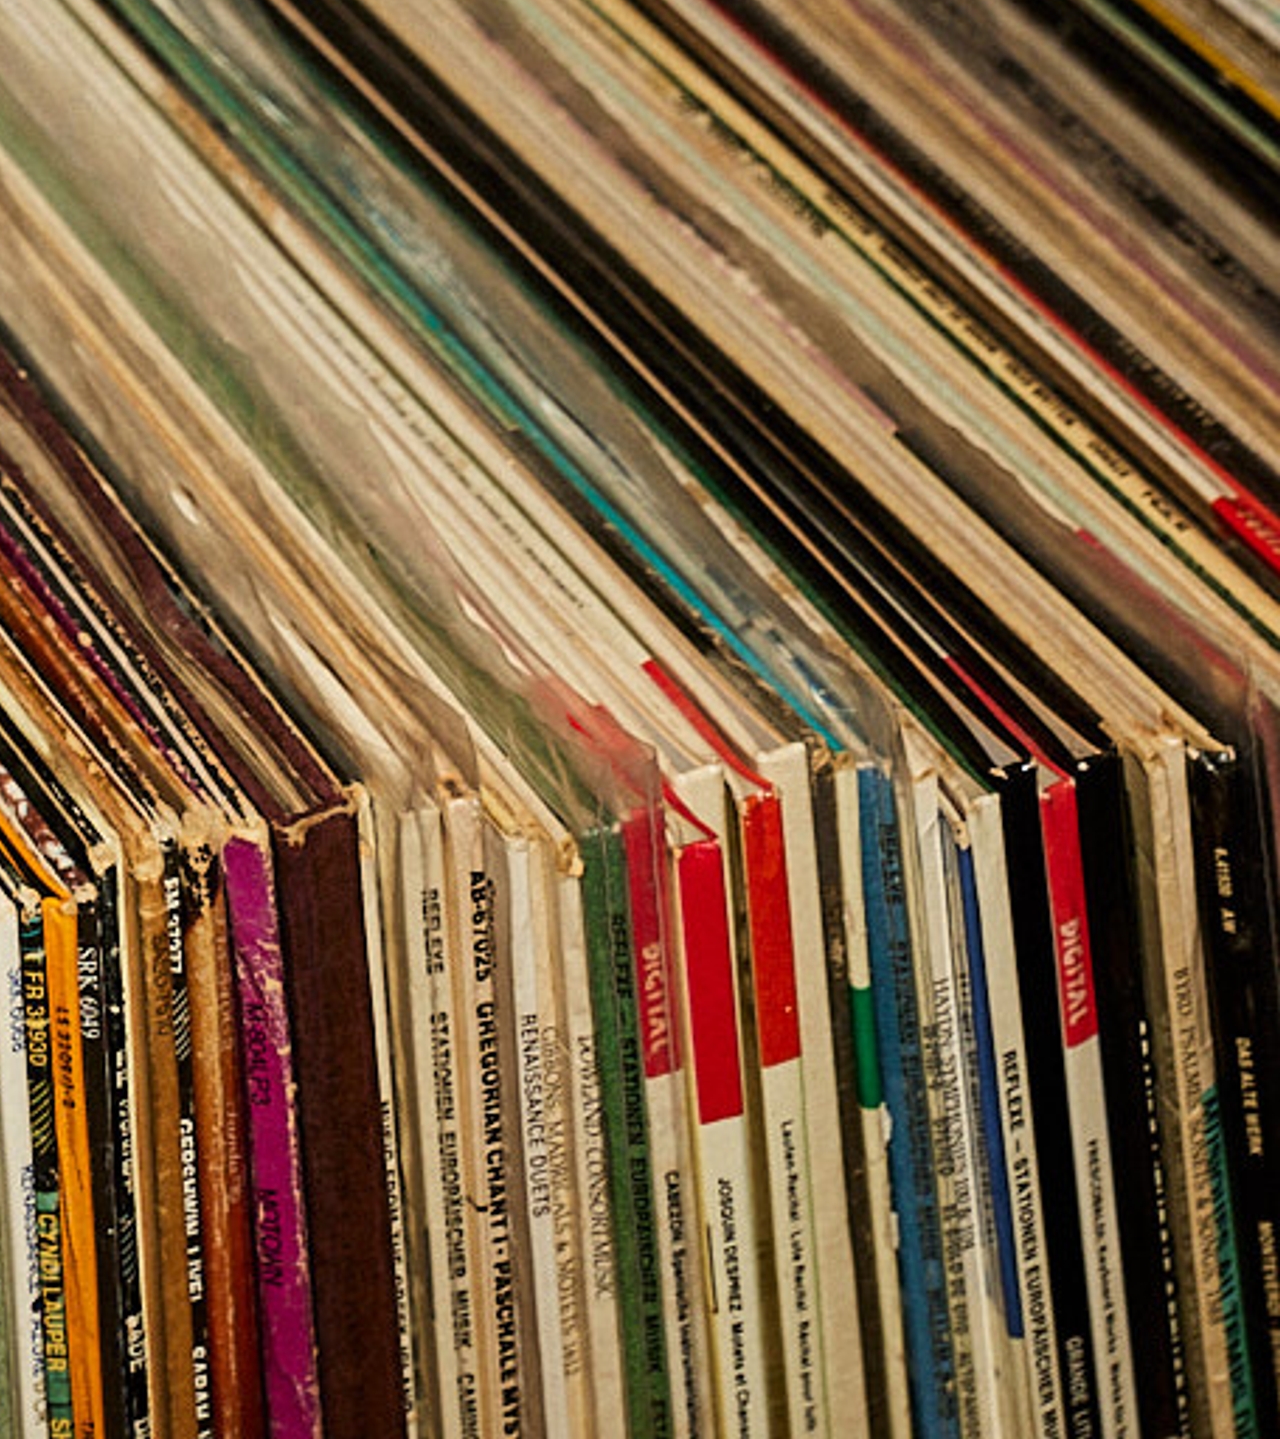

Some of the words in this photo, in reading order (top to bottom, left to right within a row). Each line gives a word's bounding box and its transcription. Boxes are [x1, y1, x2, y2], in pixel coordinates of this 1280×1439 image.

[24, 971, 45, 1000] FR
[78, 947, 98, 991] SRK
[642, 942, 668, 1054] DIGITAL
[1058, 919, 1089, 1025] DIGITAL
[79, 996, 99, 1038] 6049
[1235, 1037, 1253, 1069] DAS
[477, 1003, 503, 1144] GREGORIAN
[521, 1014, 544, 1147] RENAISSANCE
[1002, 1050, 1025, 1131] REFLEXE
[486, 1150, 508, 1226] CHANT
[530, 1156, 551, 1218] DUETS
[718, 1178, 737, 1242] JOSQUIN
[1012, 1159, 1040, 1260] STATIONEN
[38, 1214, 62, 1281] CYNDI
[258, 1189, 284, 1286] MOTOWN
[723, 1246, 742, 1311] DESPREZ
[45, 1287, 68, 1371] LAUPER
[495, 1261, 519, 1381] PASCHALE
